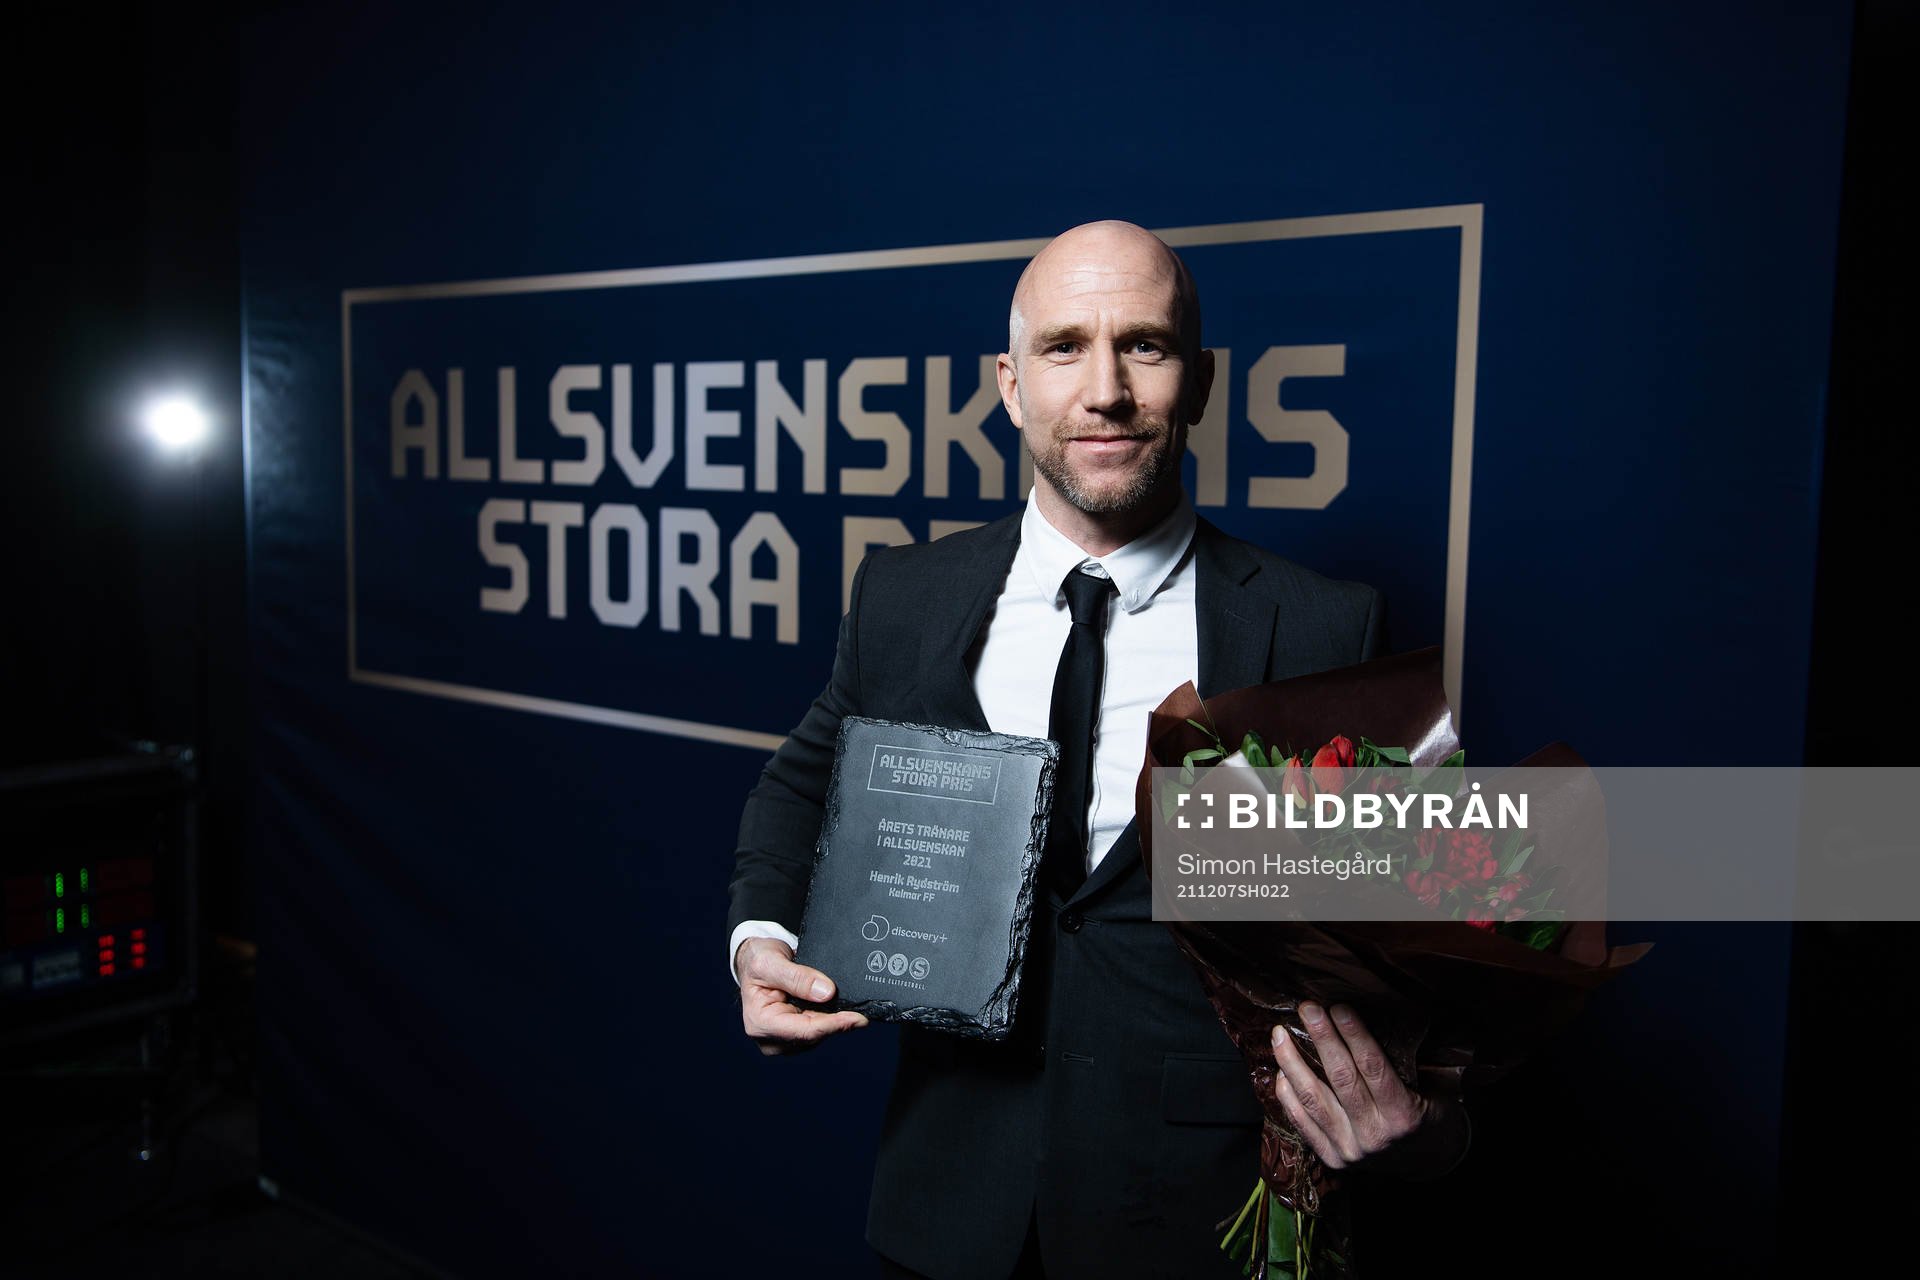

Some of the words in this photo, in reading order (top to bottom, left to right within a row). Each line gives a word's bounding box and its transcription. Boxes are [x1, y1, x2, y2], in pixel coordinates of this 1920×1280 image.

[391, 344, 1349, 510] ALLSVENSKS
[478, 499, 799, 645] STORA
[880, 754, 992, 780] ALLSVENSKANS
[891, 770, 938, 788] STORA
[940, 775, 974, 792] PRIS
[878, 818, 915, 834] ÅRETS
[917, 825, 971, 842] TRÄNARE
[876, 835, 882, 846] I
[882, 836, 966, 857] ALLSVENSKAN
[903, 854, 932, 869] 2021
[869, 870, 904, 886] Henrik
[906, 875, 960, 893] Rydström
[888, 887, 922, 901] Kalmar
[922, 892, 936, 902] FF
[891, 926, 948, 943] discovery+
